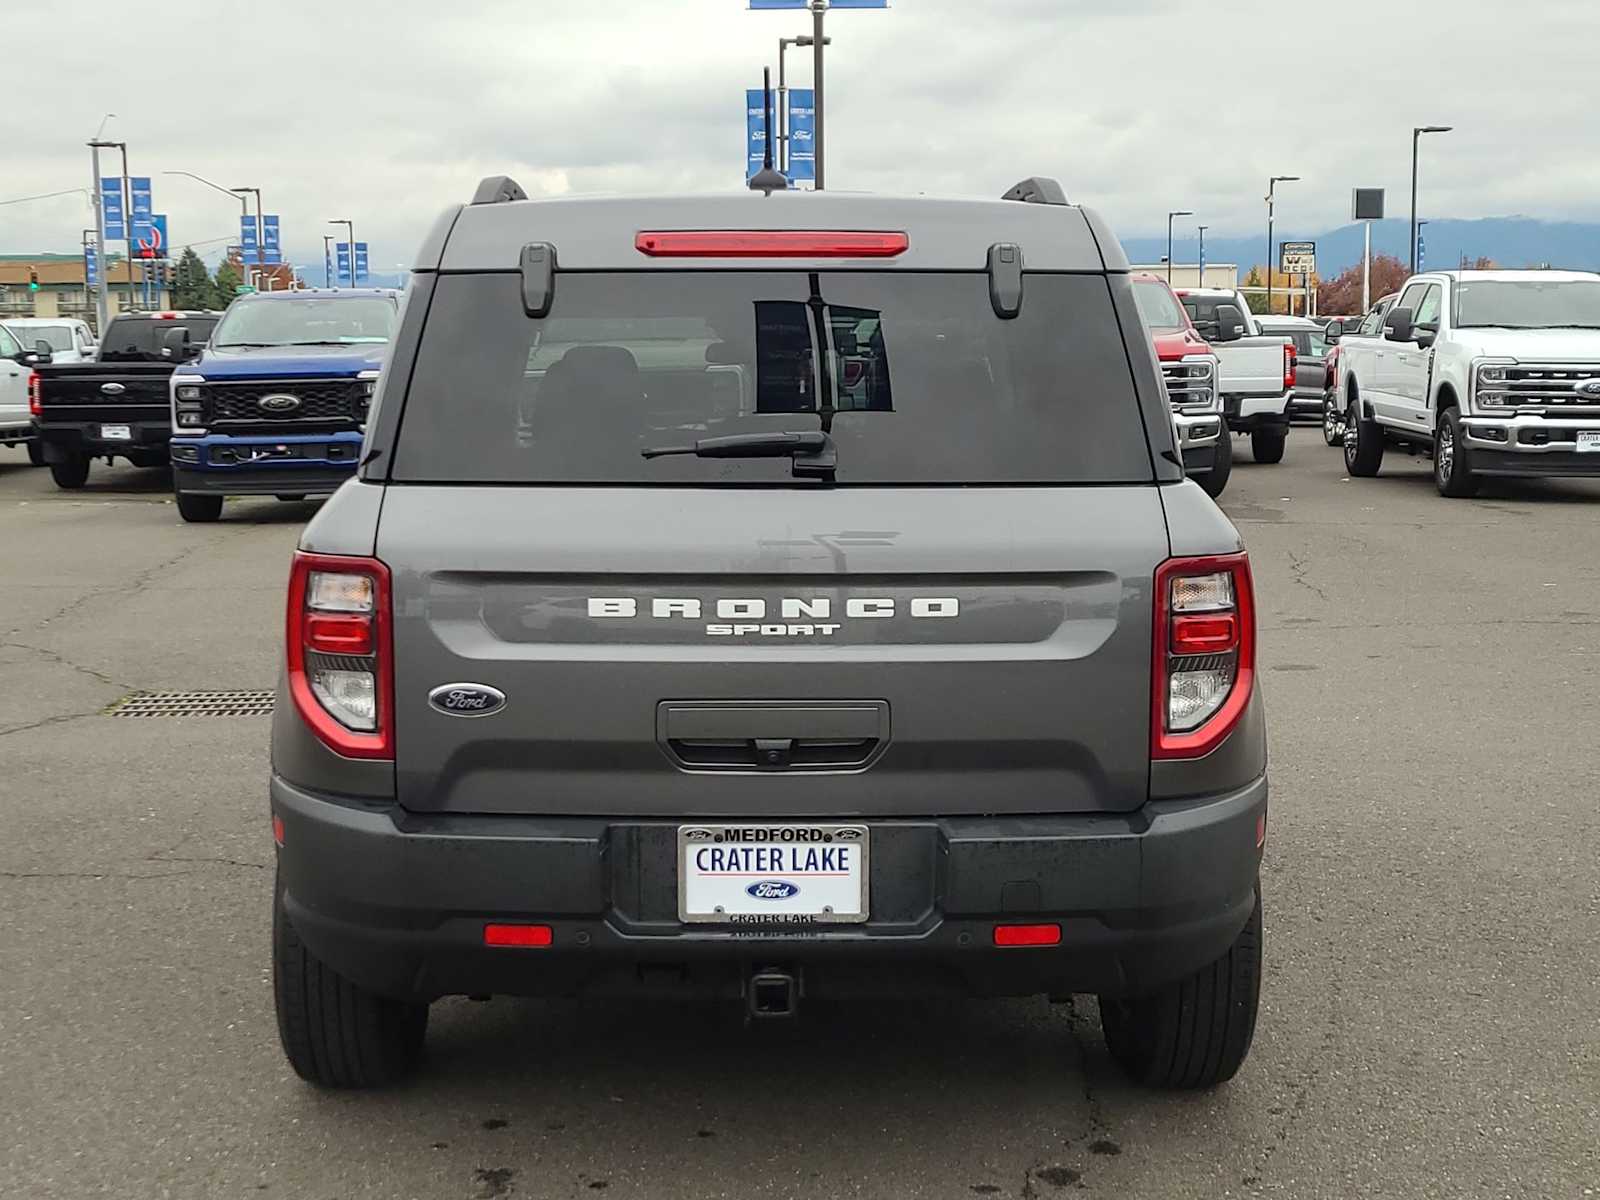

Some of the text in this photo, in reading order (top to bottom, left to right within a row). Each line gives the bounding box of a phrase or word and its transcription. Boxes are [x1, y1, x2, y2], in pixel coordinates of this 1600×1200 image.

[588, 598, 960, 619] BRONCO
[706, 624, 841, 636] SPORT
[724, 829, 823, 842] MEDFORD
[696, 848, 849, 871] CRATER LAKE
[755, 881, 791, 899] Ford
[729, 913, 817, 924] CRATER LAKE
